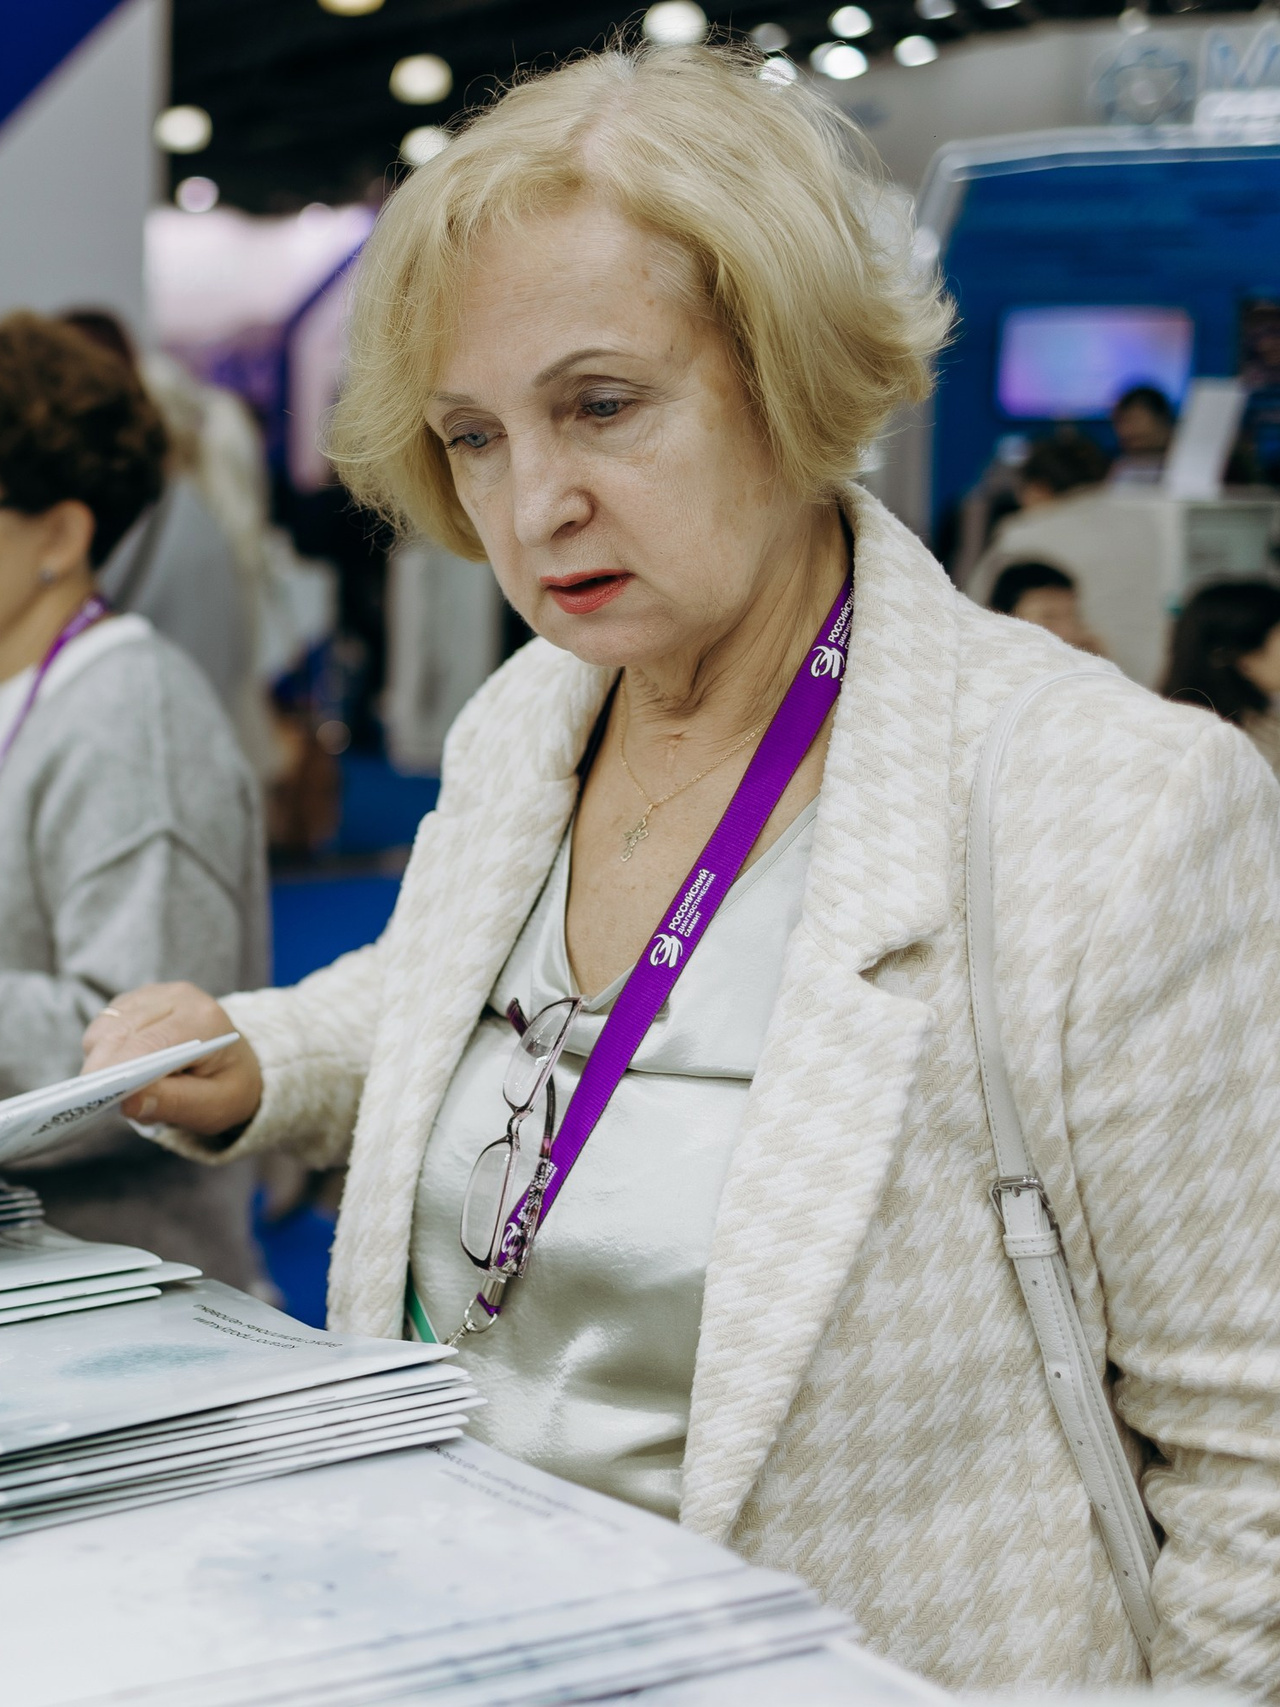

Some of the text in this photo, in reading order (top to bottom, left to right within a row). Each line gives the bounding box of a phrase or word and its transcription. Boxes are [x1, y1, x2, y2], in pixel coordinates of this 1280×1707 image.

[668, 868, 710, 931] РОССИЙСКИЙ
[677, 873, 716, 935] ДИАГНОСТИЧЕСКИЙ
[684, 911, 702, 938] САММИТ
